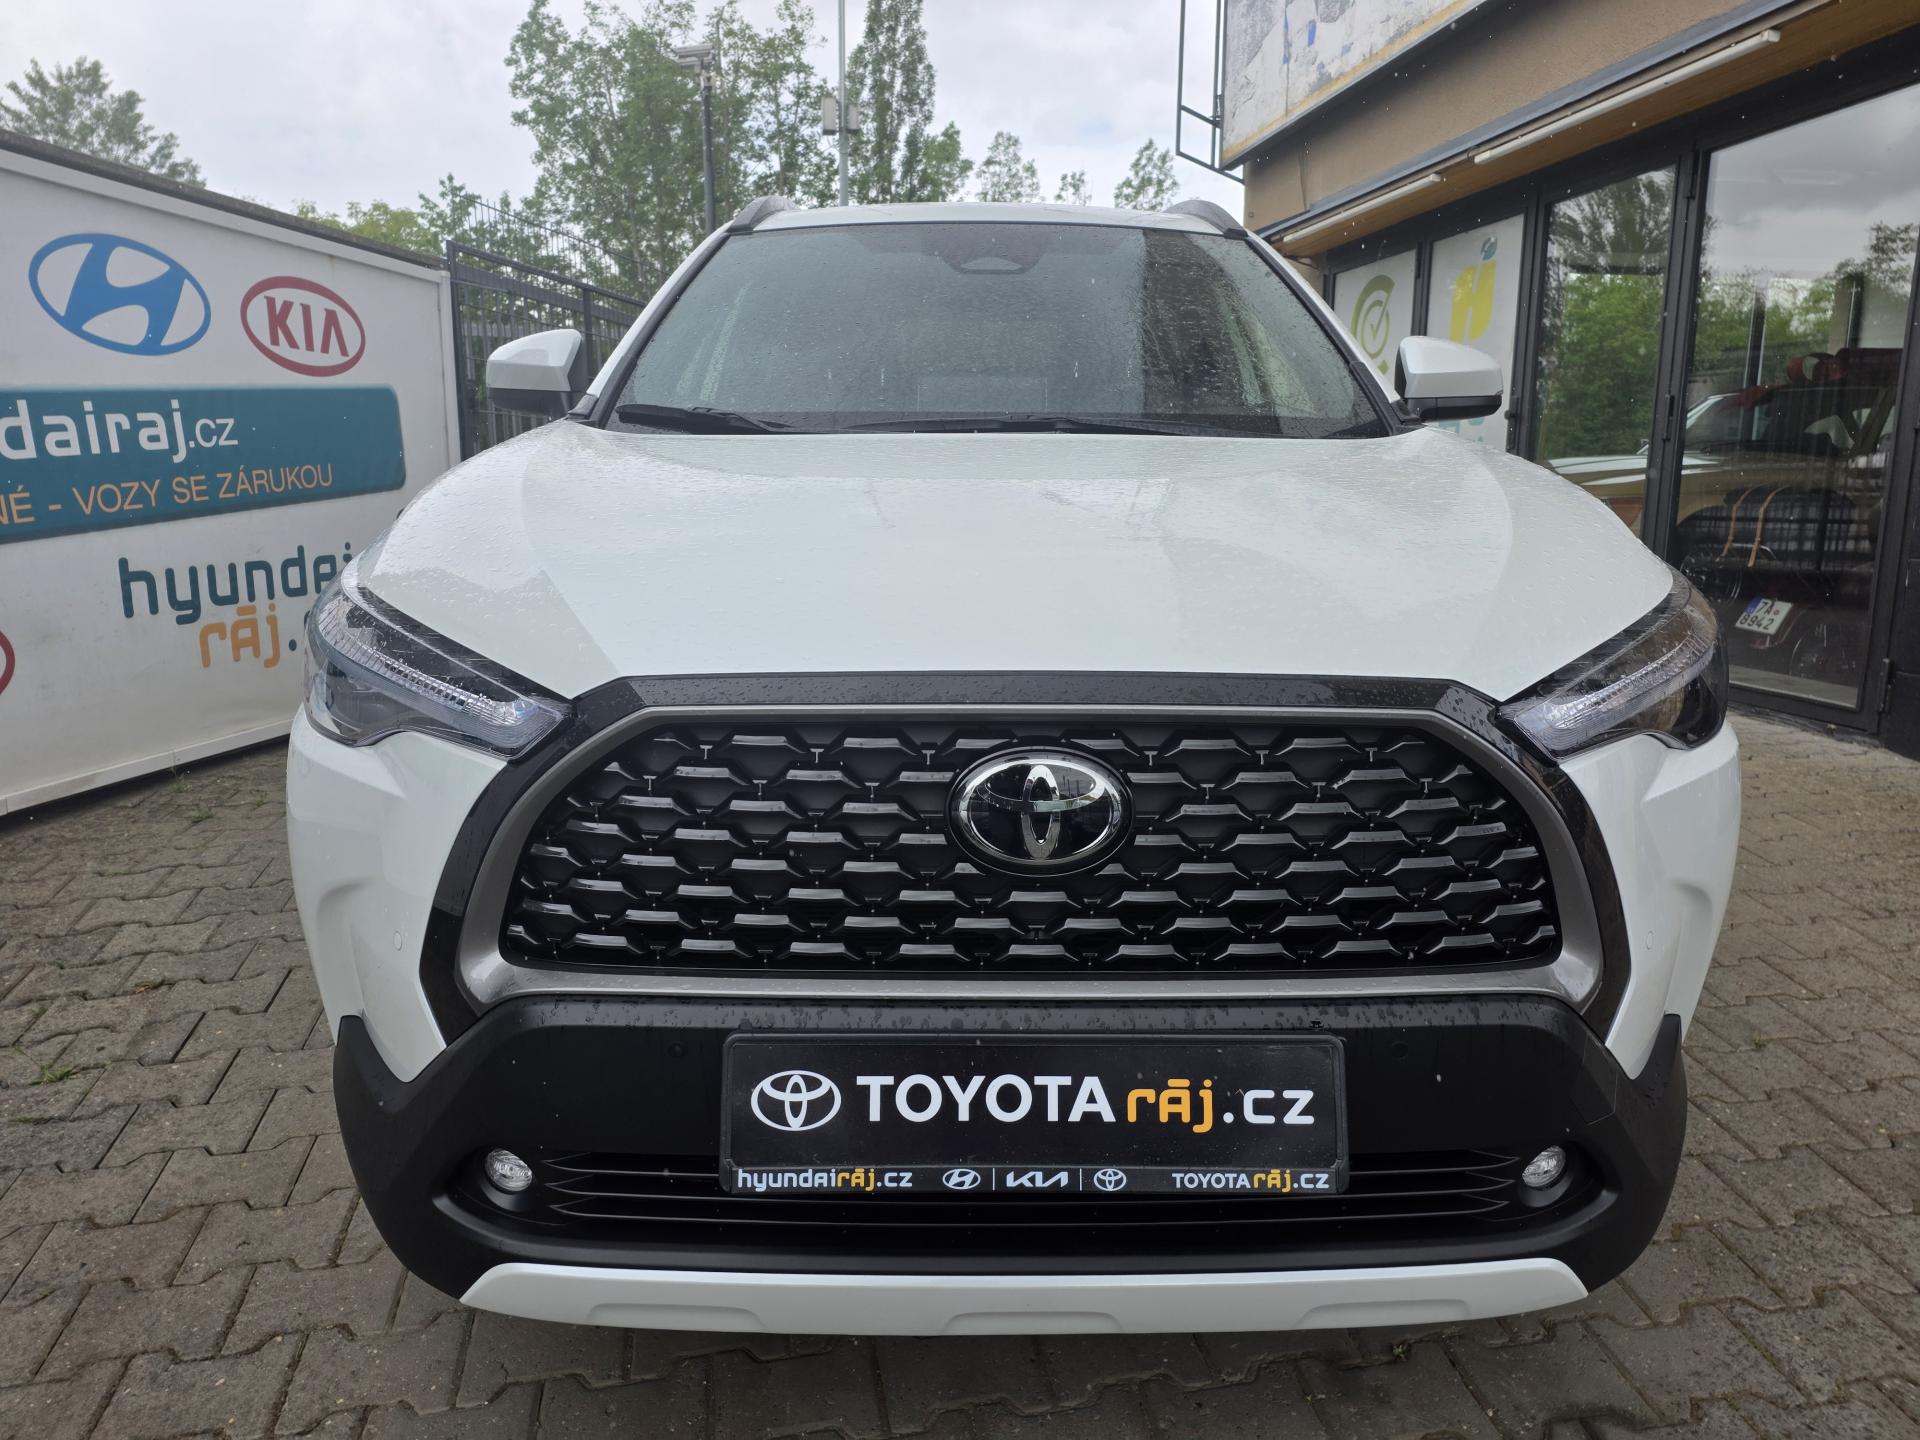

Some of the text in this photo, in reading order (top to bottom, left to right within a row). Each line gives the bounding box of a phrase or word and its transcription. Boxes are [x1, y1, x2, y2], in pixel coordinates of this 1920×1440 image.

[264, 295, 349, 357] KIA
[72, 480, 161, 516] VOZY
[173, 474, 208, 505] SE
[217, 463, 334, 496] ZÁRUKOU
